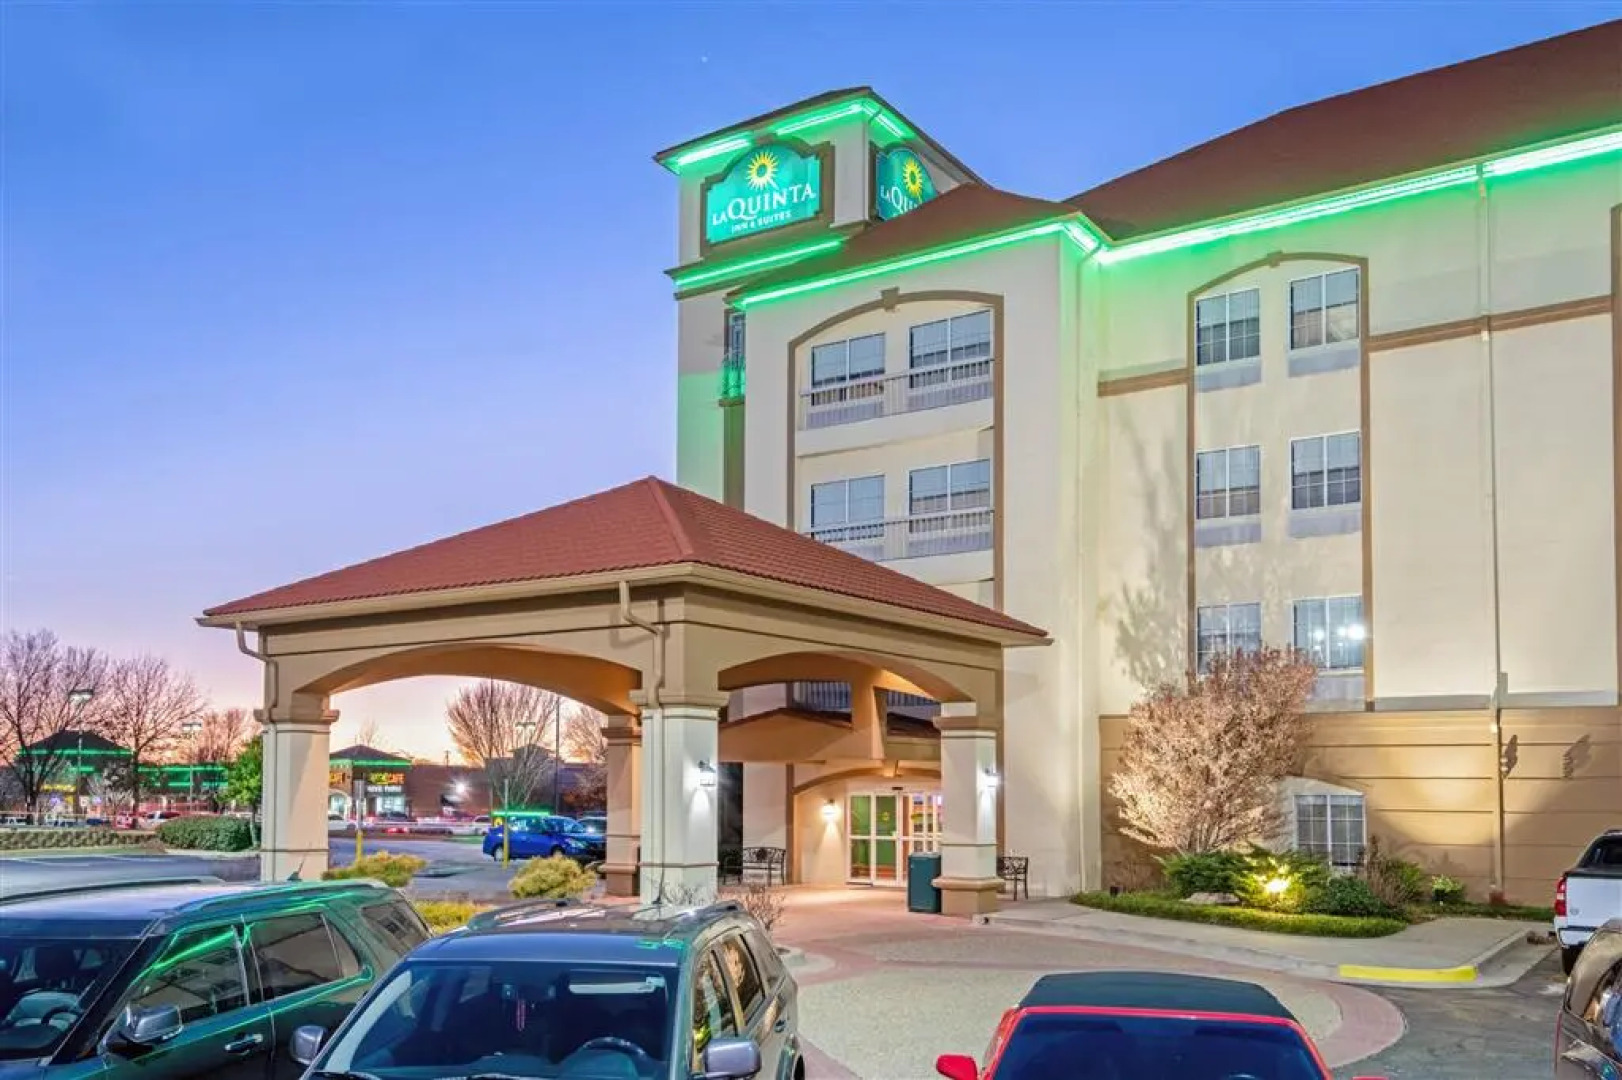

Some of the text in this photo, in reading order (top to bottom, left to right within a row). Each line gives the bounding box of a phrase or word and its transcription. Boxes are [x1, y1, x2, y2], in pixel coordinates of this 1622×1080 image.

[712, 182, 817, 226] LA QUINTA
[731, 221, 748, 235] INN
[758, 210, 792, 227] SUITES
